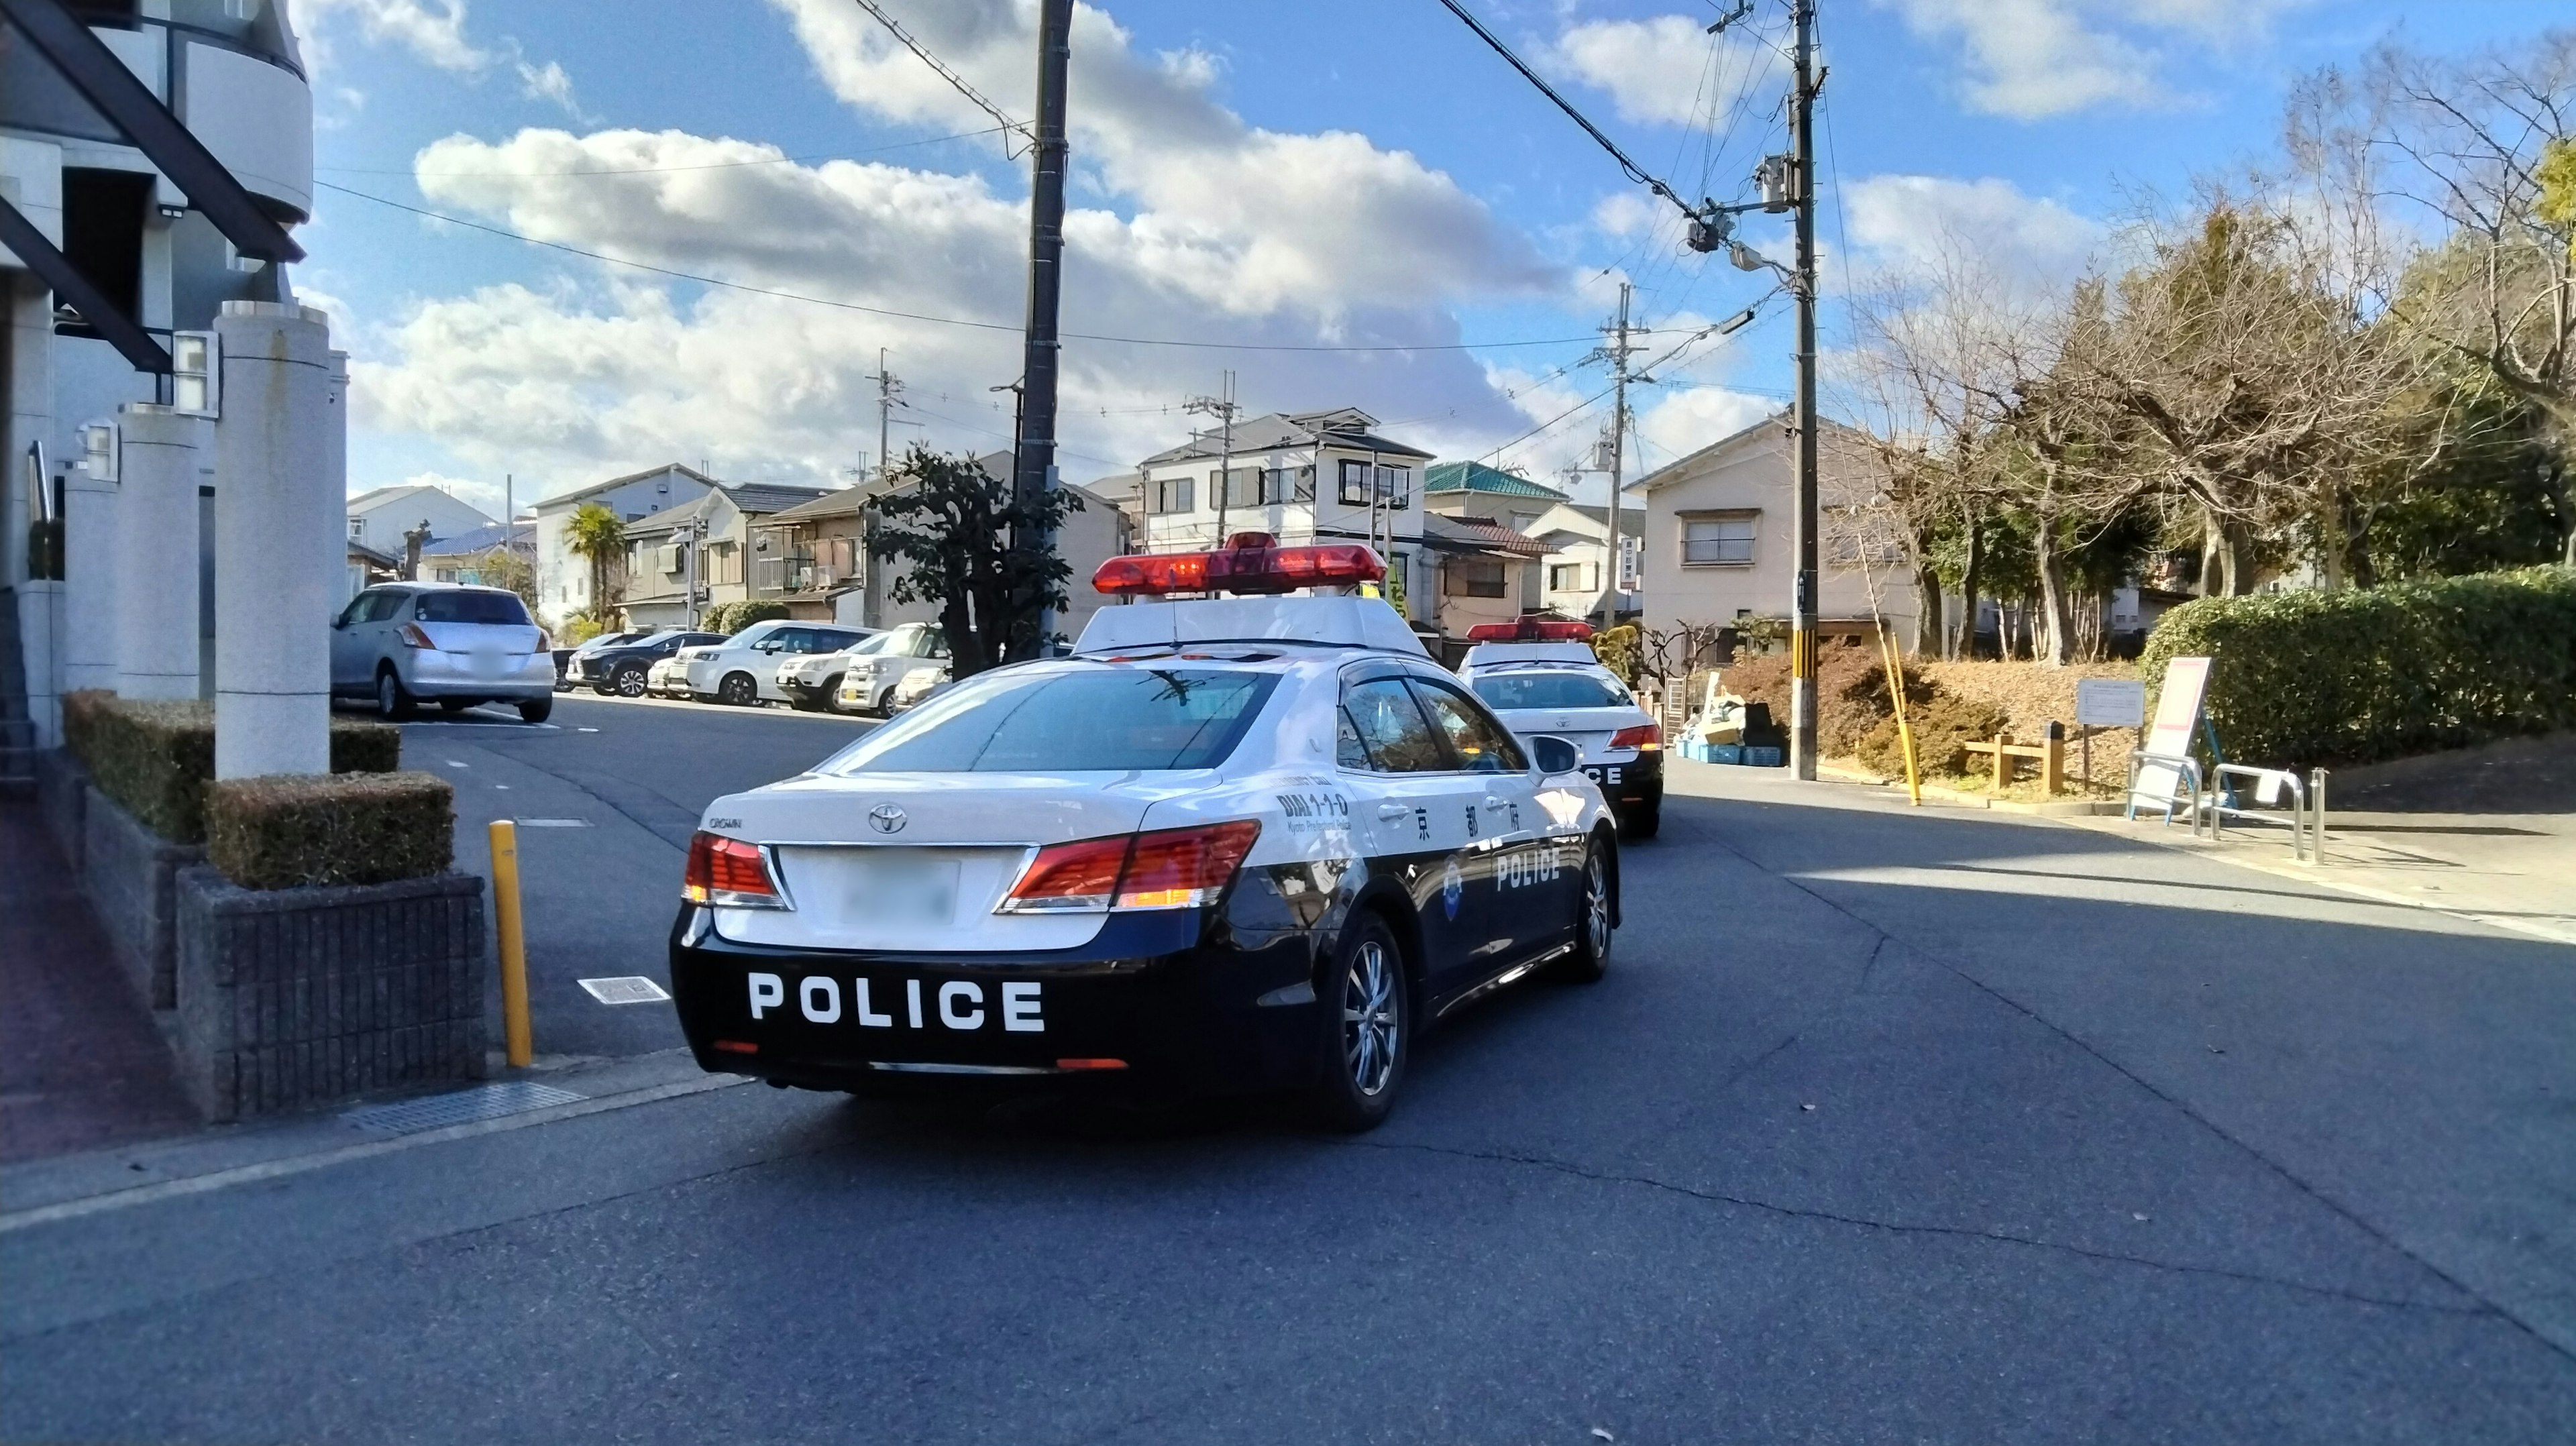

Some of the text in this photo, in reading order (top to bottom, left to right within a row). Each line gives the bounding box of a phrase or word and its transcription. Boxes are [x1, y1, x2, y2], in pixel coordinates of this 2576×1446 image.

[1276, 793, 1348, 817] DIAL 1-1-0
[709, 818, 743, 829] CROWN
[1287, 819, 1352, 835] Kyoto Prefectural Police
[1497, 847, 1560, 892] POLICE
[748, 972, 1044, 1032] POLICE
